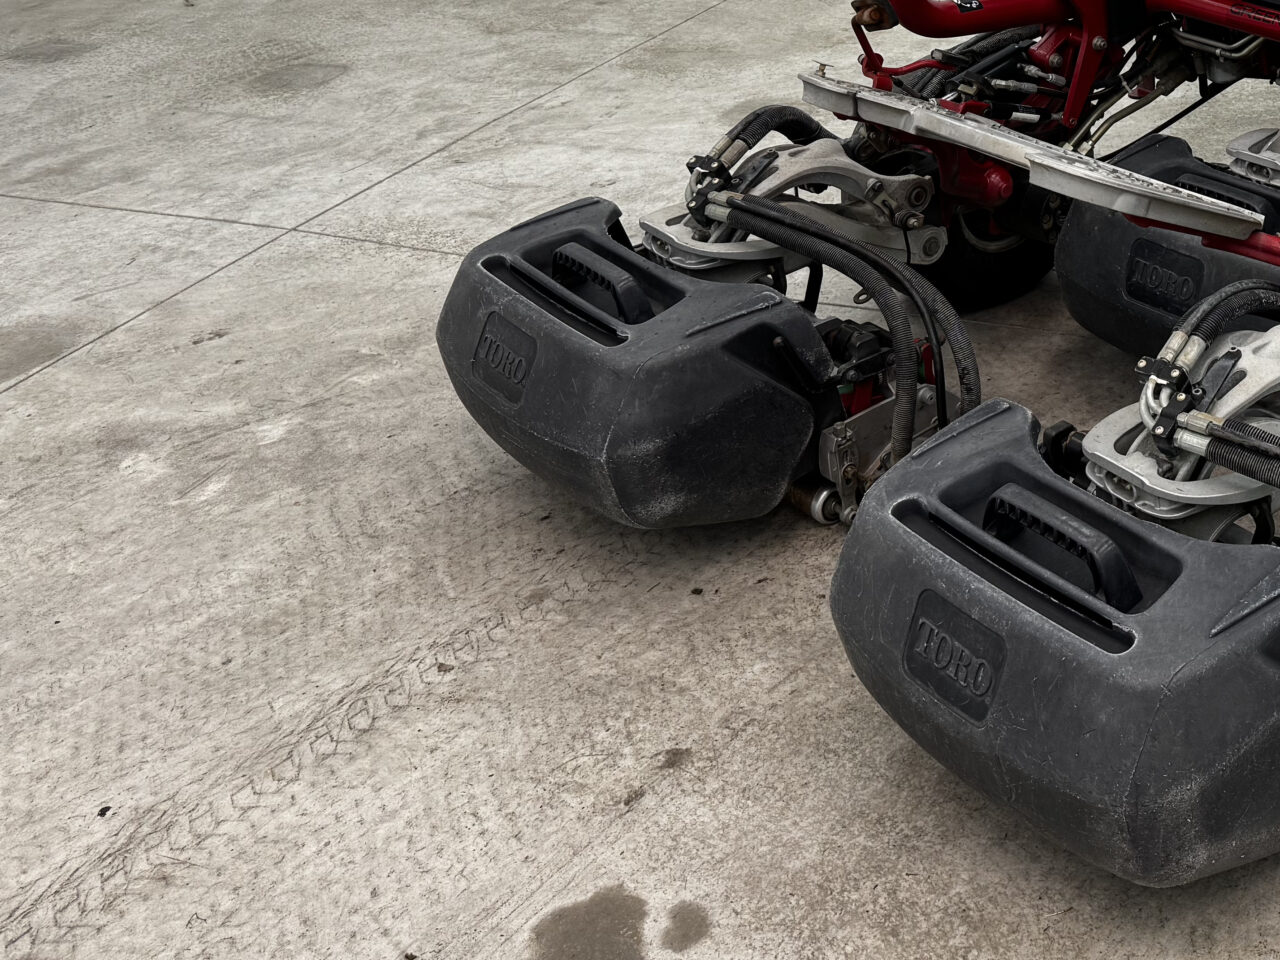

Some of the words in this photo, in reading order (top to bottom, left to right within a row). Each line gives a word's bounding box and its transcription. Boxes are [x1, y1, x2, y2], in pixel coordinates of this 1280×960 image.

[1128, 257, 1194, 302] TORO
[480, 334, 528, 385] TORO
[913, 616, 994, 698] TORO
